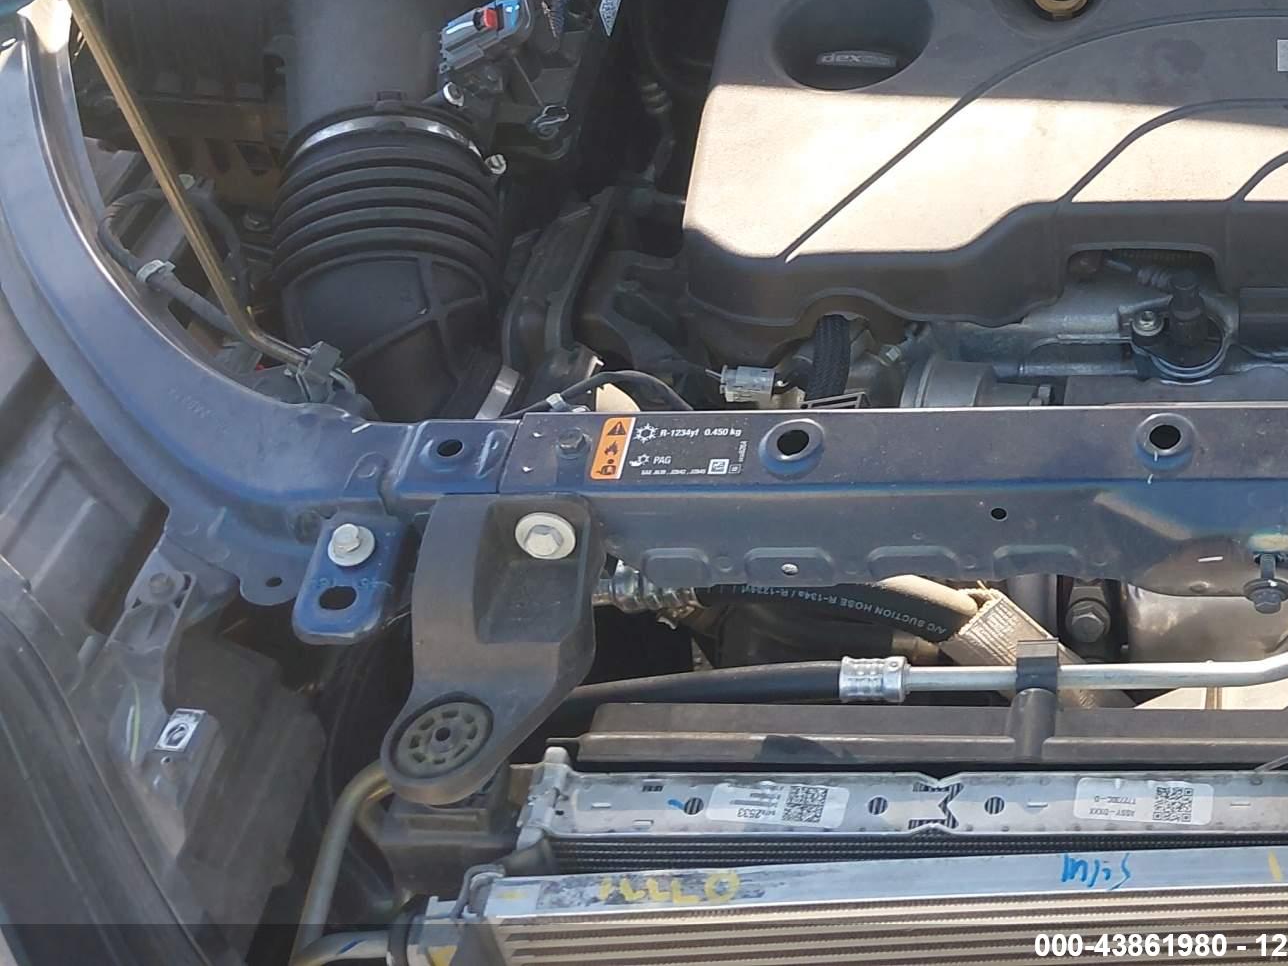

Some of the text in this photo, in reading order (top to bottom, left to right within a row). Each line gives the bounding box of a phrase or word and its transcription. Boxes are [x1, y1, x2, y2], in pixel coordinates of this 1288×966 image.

[659, 428, 742, 438] R-1234yf 0.450 kg
[653, 456, 672, 465] PAG
[798, 590, 838, 604] R-134a
[840, 597, 873, 612] HOSE
[874, 605, 926, 628] SUCTION
[926, 623, 947, 634] A/C
